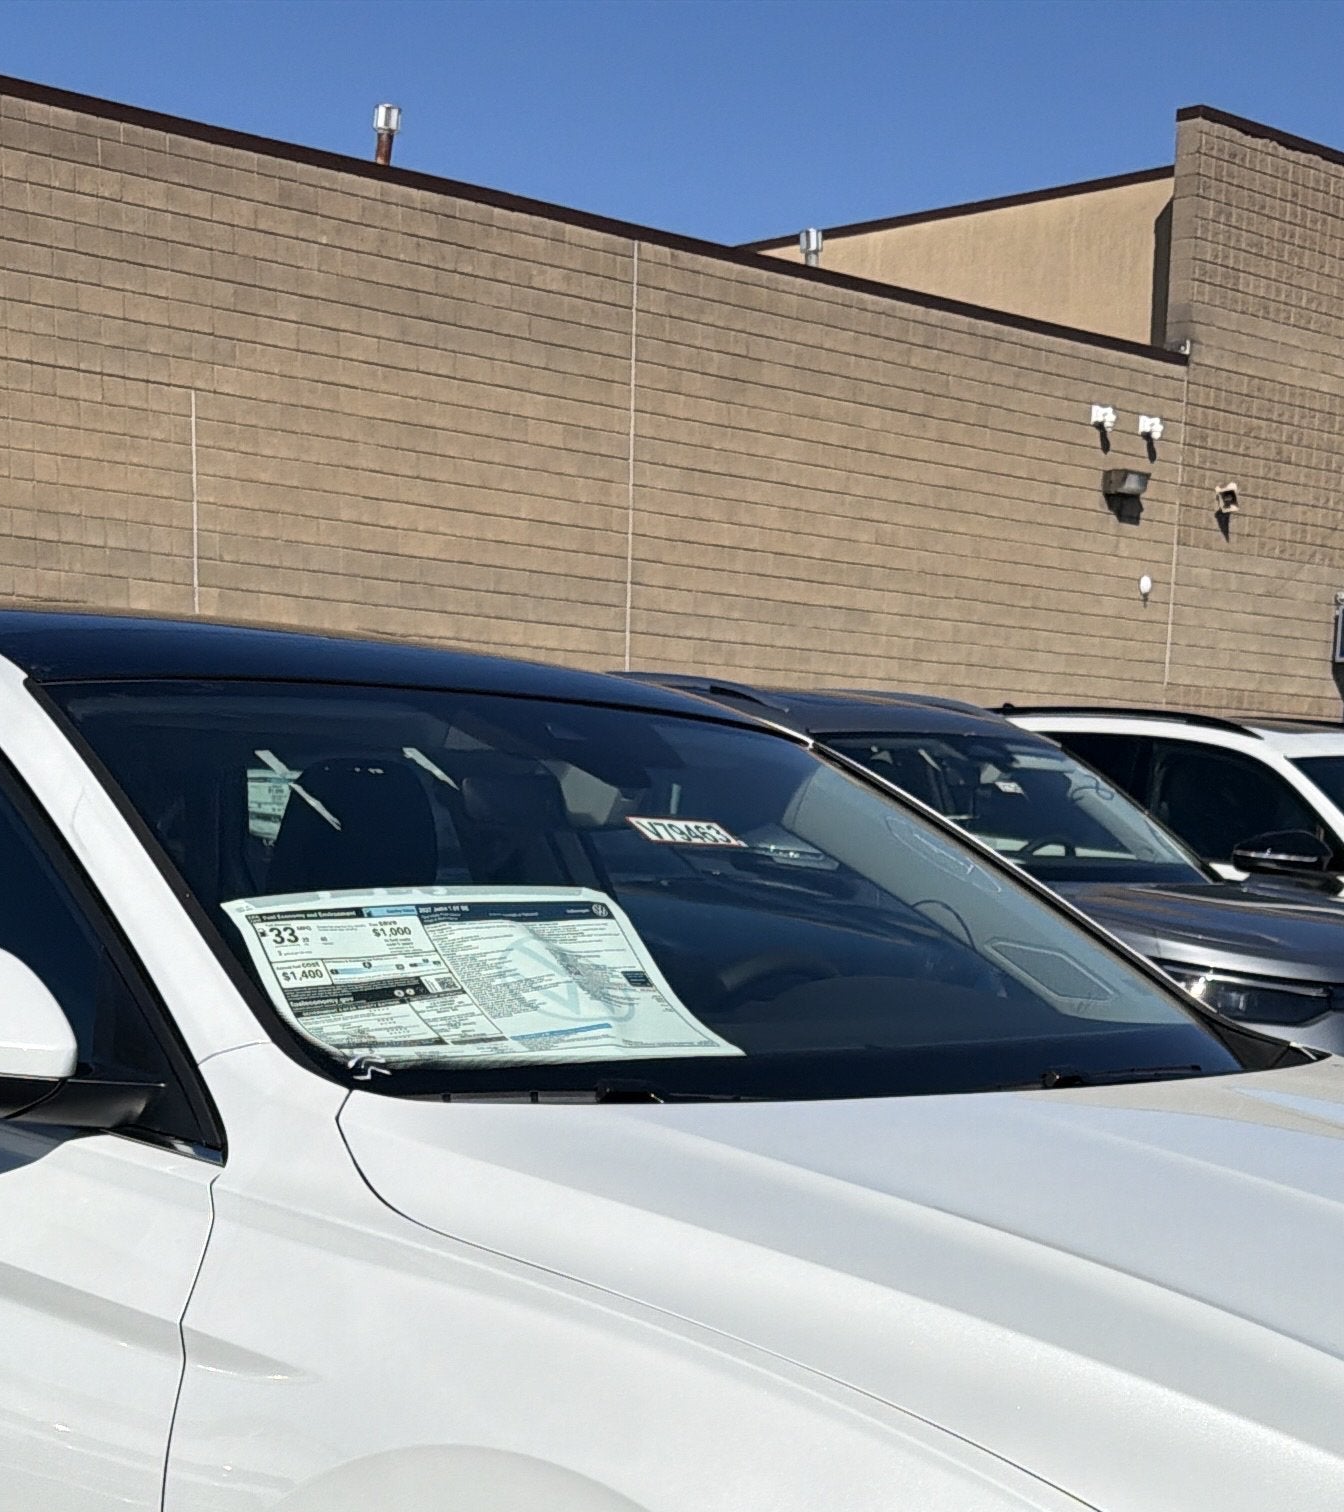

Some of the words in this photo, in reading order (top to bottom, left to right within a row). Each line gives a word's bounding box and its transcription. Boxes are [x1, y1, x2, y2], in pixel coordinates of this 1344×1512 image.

[634, 820, 732, 843] V79463
[268, 926, 300, 944] 33
[371, 926, 412, 938] $1,000
[281, 968, 324, 982] $1,400
